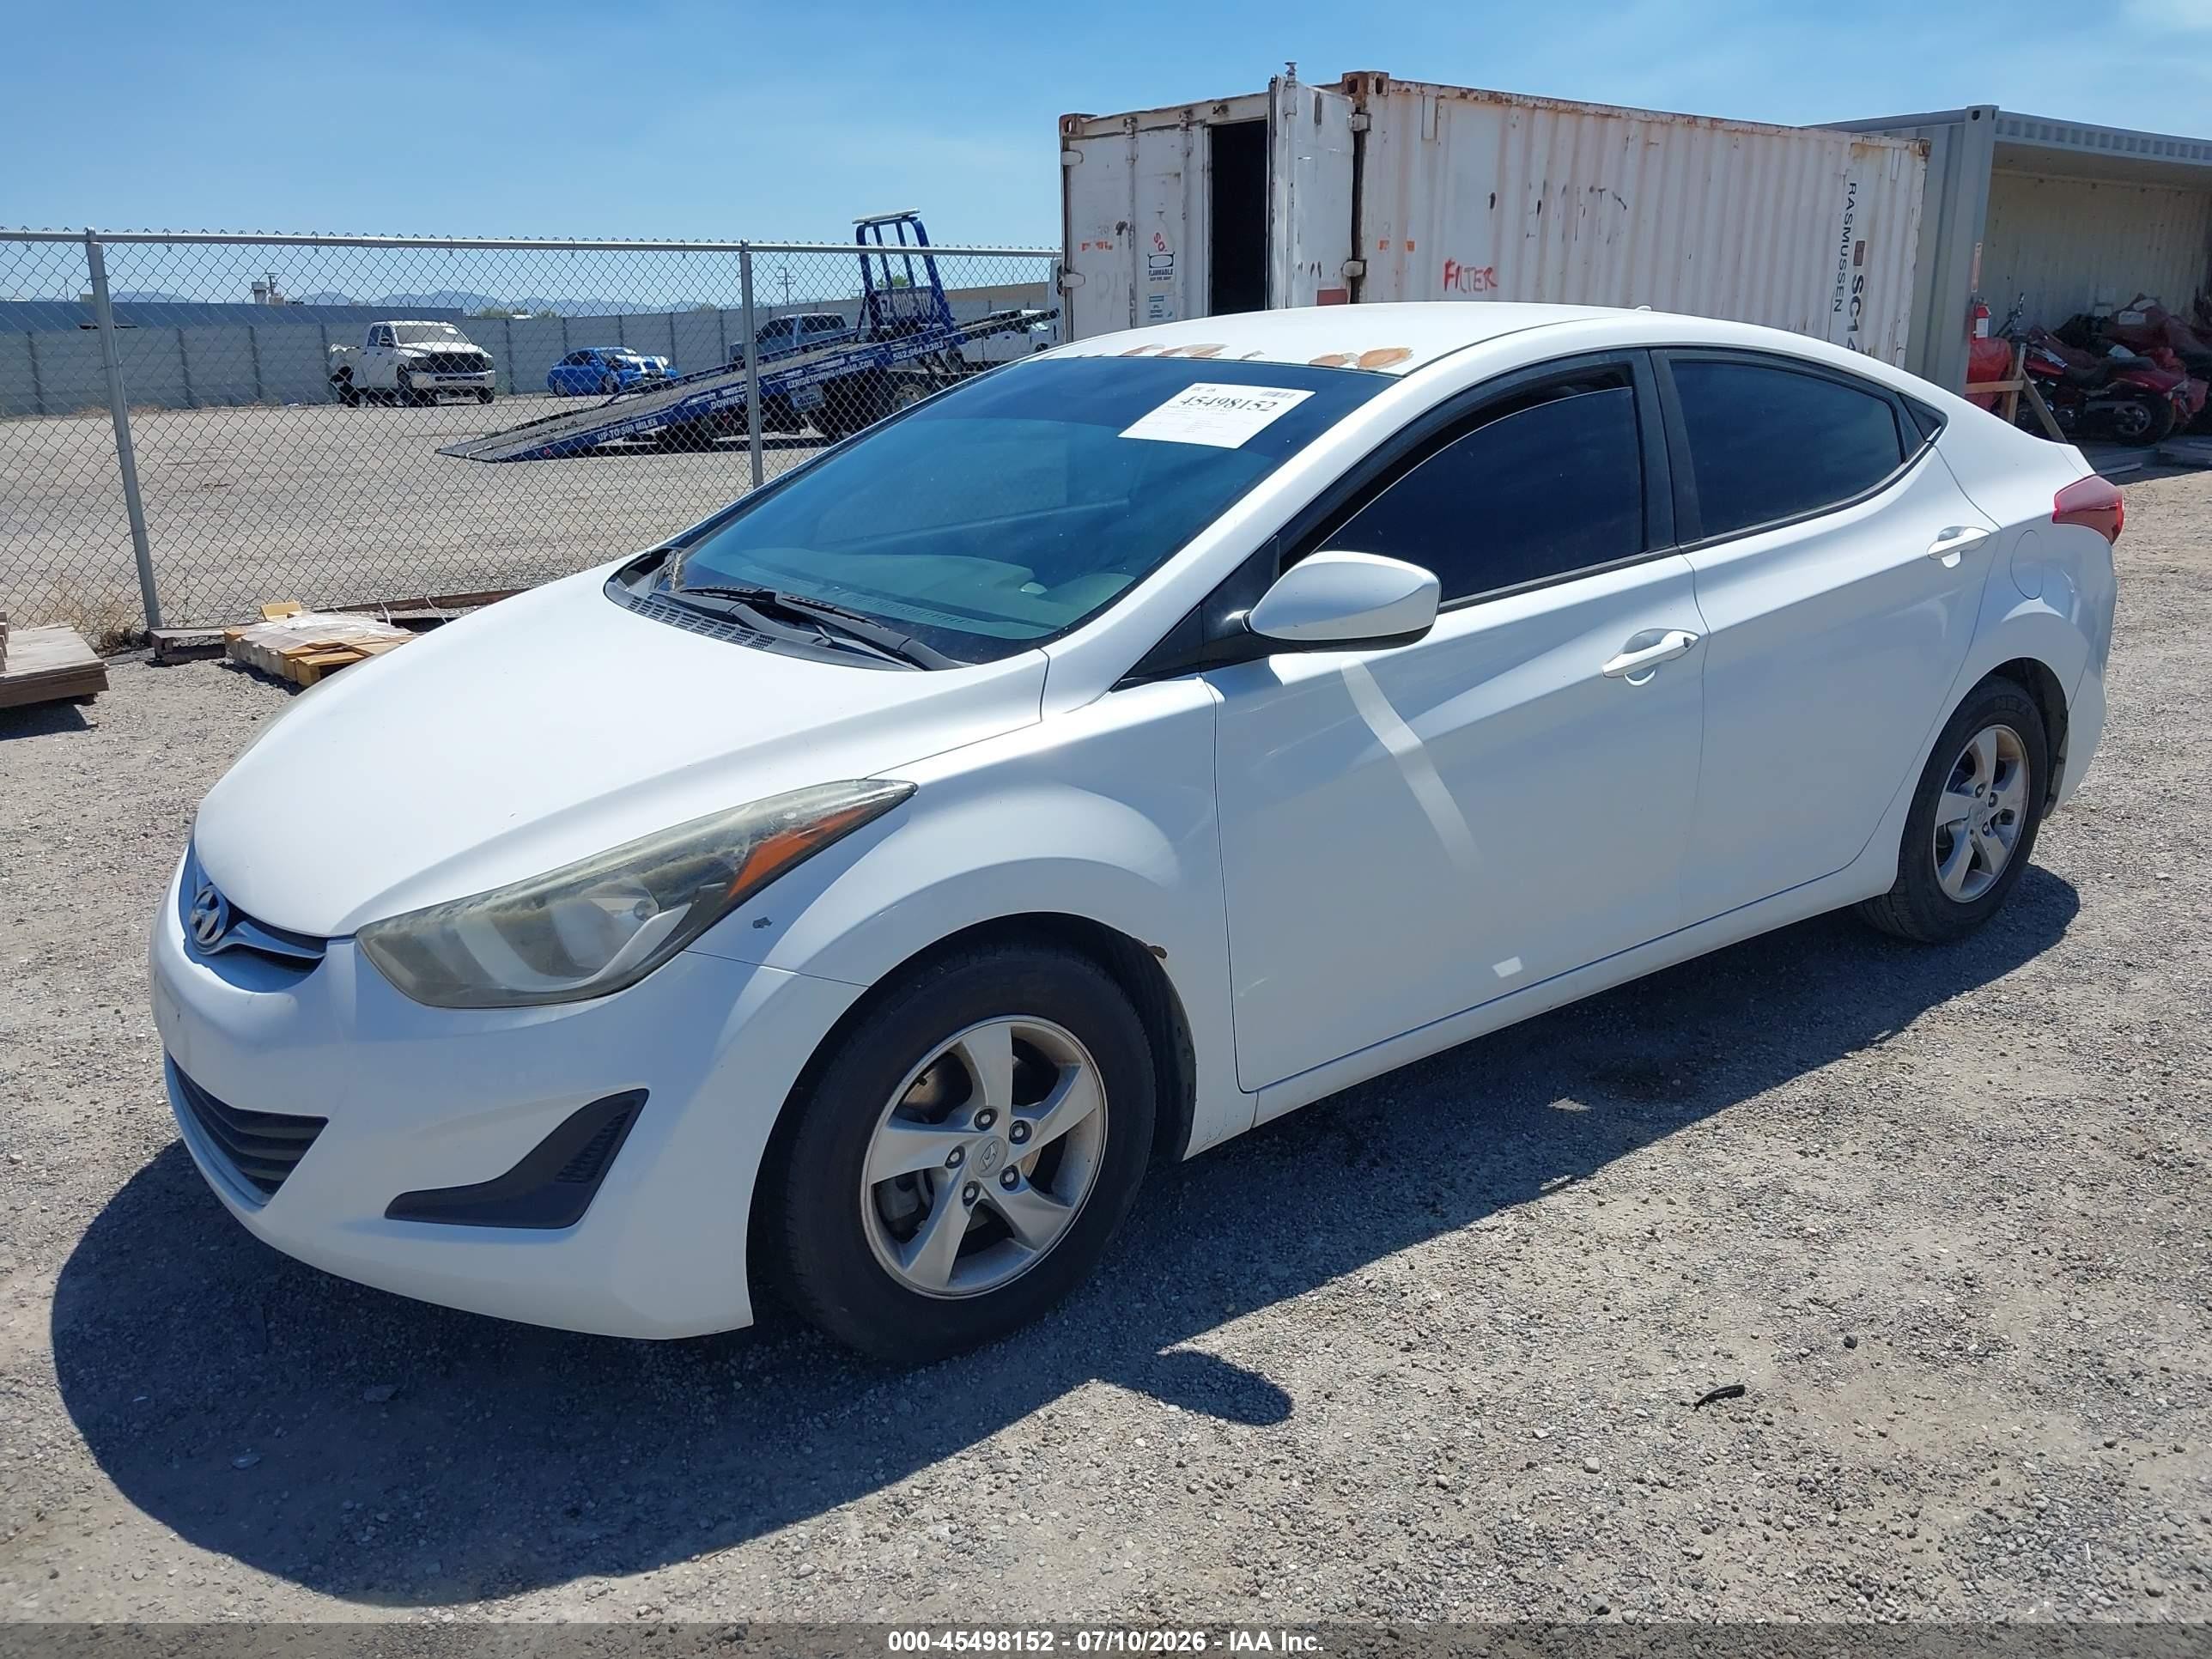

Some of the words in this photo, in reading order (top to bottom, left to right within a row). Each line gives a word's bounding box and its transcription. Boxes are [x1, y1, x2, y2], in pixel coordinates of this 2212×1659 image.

[1833, 182, 1857, 313] RASMUSSEN
[1444, 258, 1498, 294] FILTER
[1180, 395, 1279, 411] 45498152
[597, 432, 611, 442] UP
[635, 418, 659, 431] MILES
